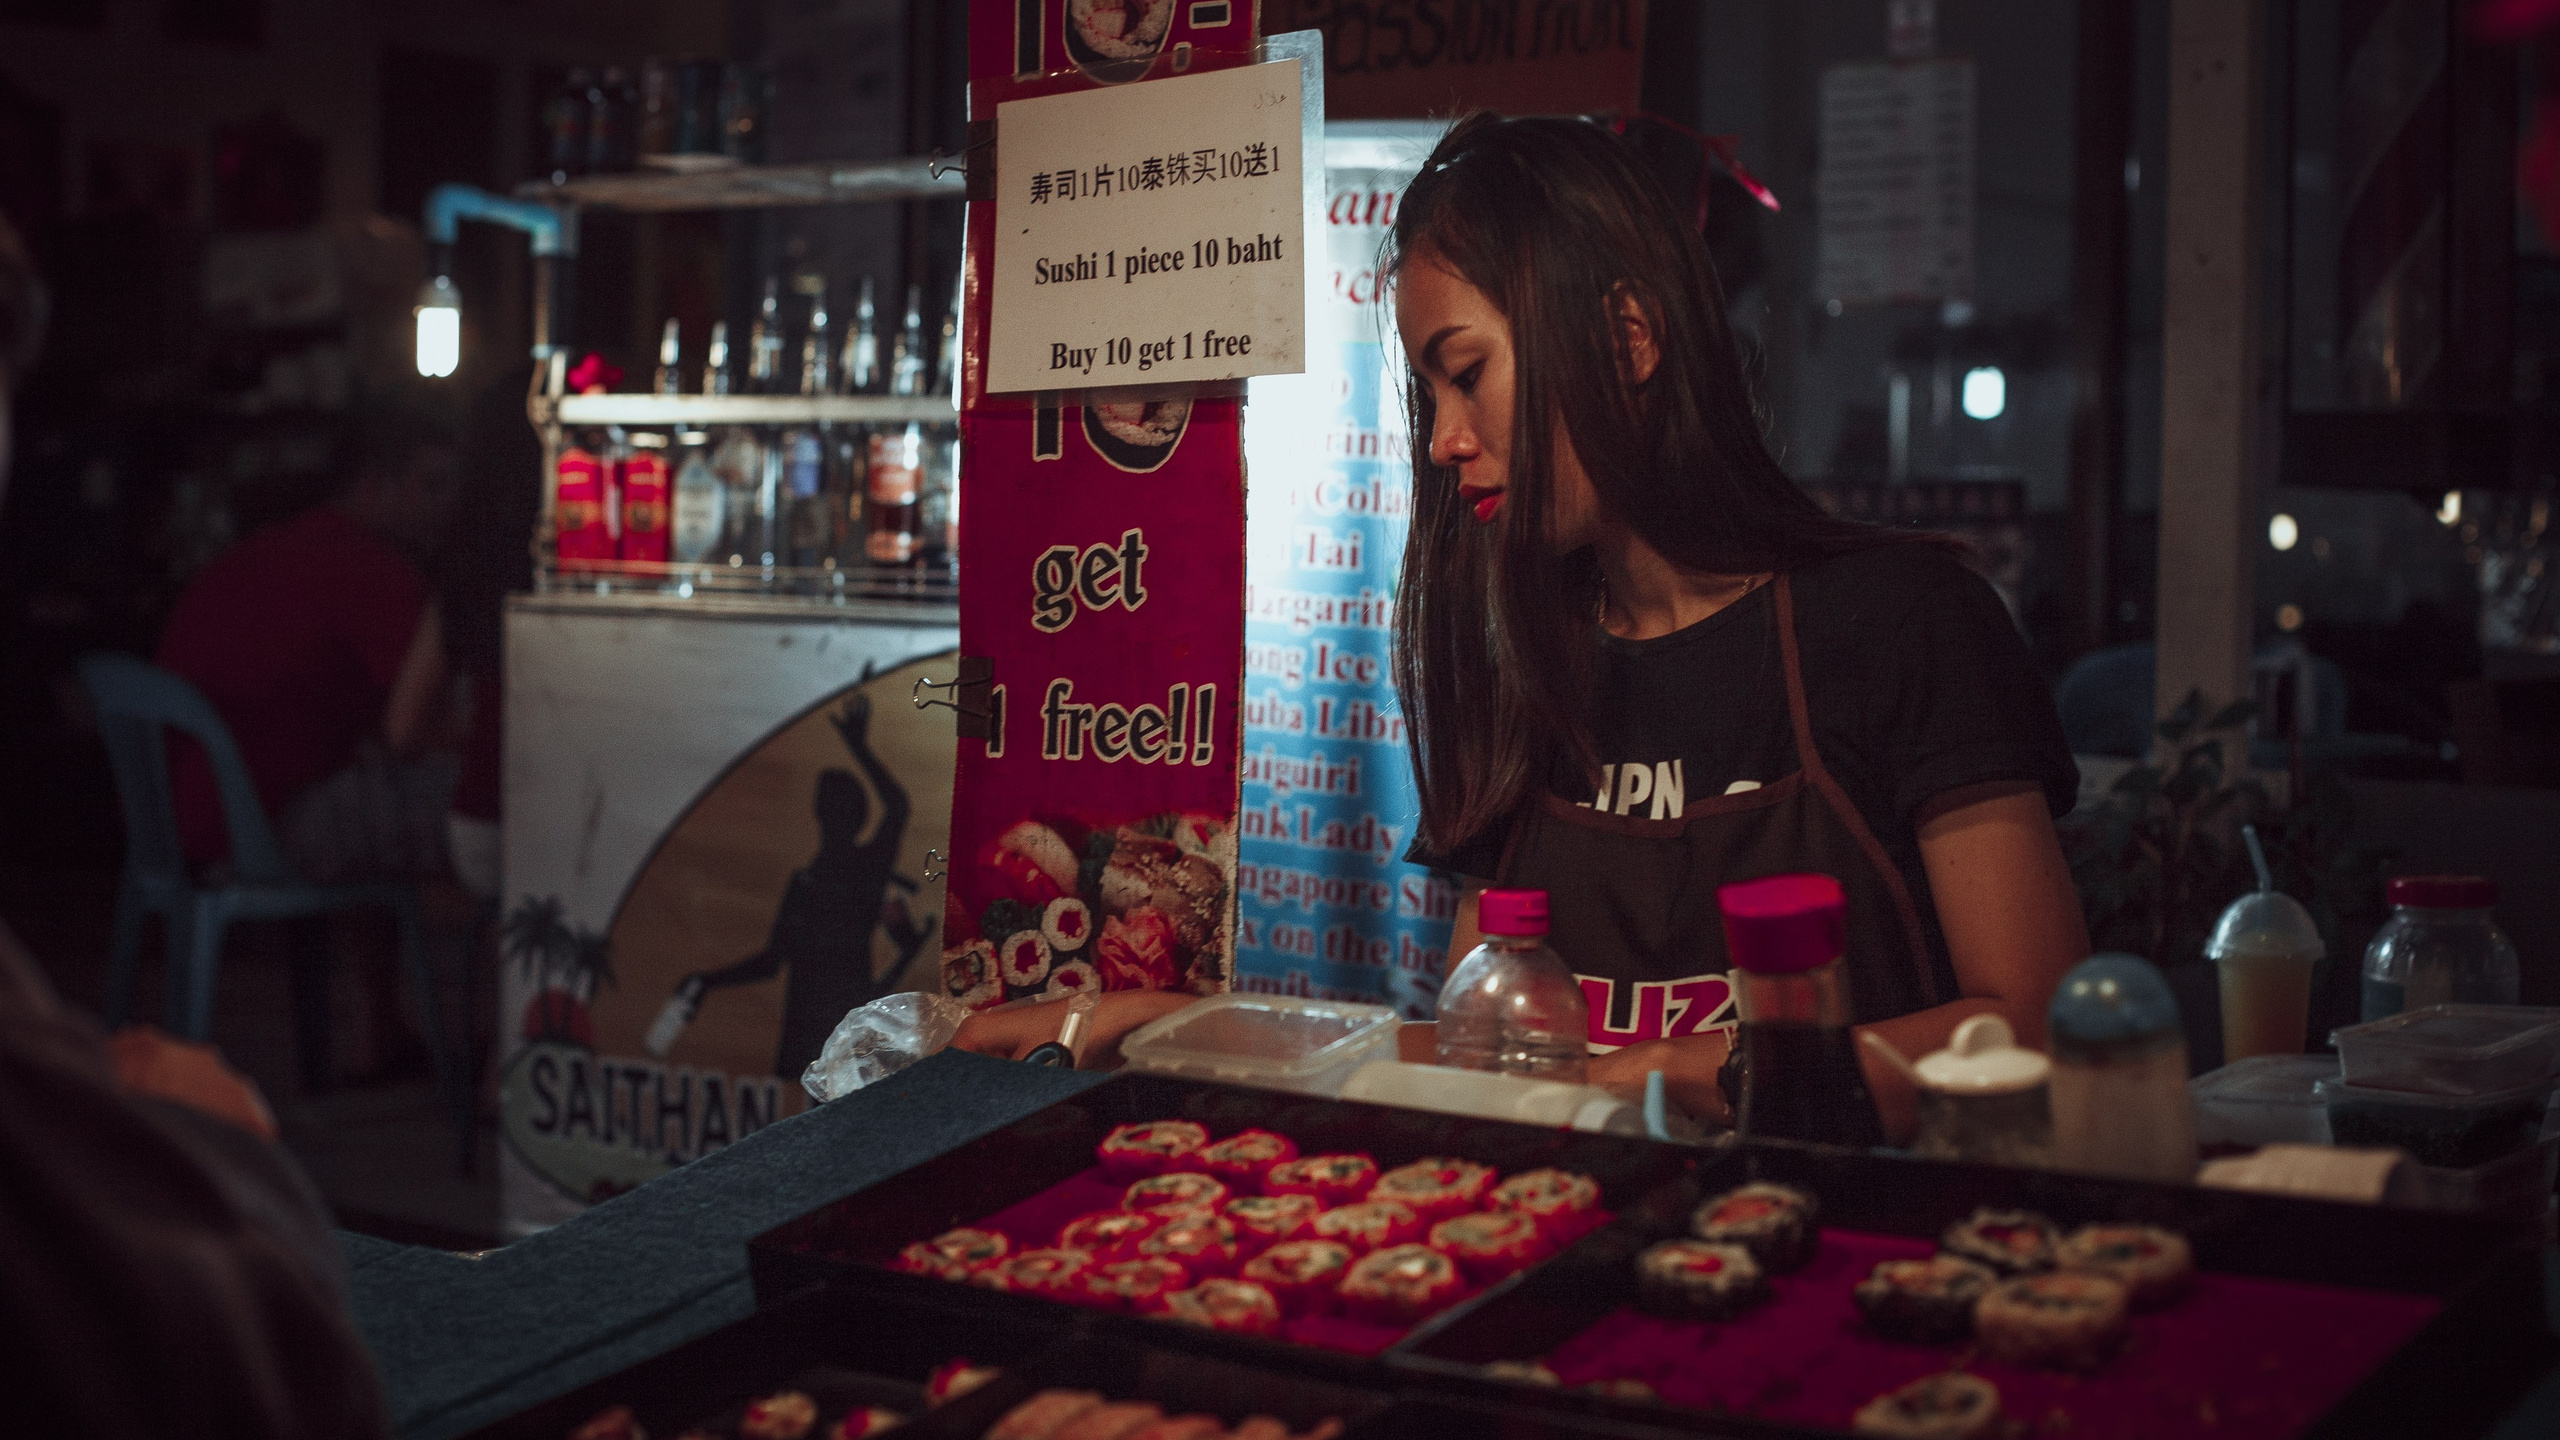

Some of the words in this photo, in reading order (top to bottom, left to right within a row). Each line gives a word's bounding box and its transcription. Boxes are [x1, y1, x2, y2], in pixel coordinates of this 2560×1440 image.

[1029, 140, 1281, 206] 寿司1片10泰铢买10送1
[1034, 252, 1098, 286] Sushi
[1104, 250, 1118, 278] 1
[1125, 245, 1185, 284] piece
[1192, 238, 1219, 271] 10
[1227, 232, 1284, 267] baht
[1050, 341, 1098, 375] Buy
[1105, 336, 1131, 367] 10
[1138, 336, 1176, 370] get
[1183, 331, 1194, 360] 1
[1202, 329, 1252, 358] free
[1031, 527, 1149, 634] get
[1040, 677, 1217, 767] free!!
[1298, 808, 1399, 867] Lady
